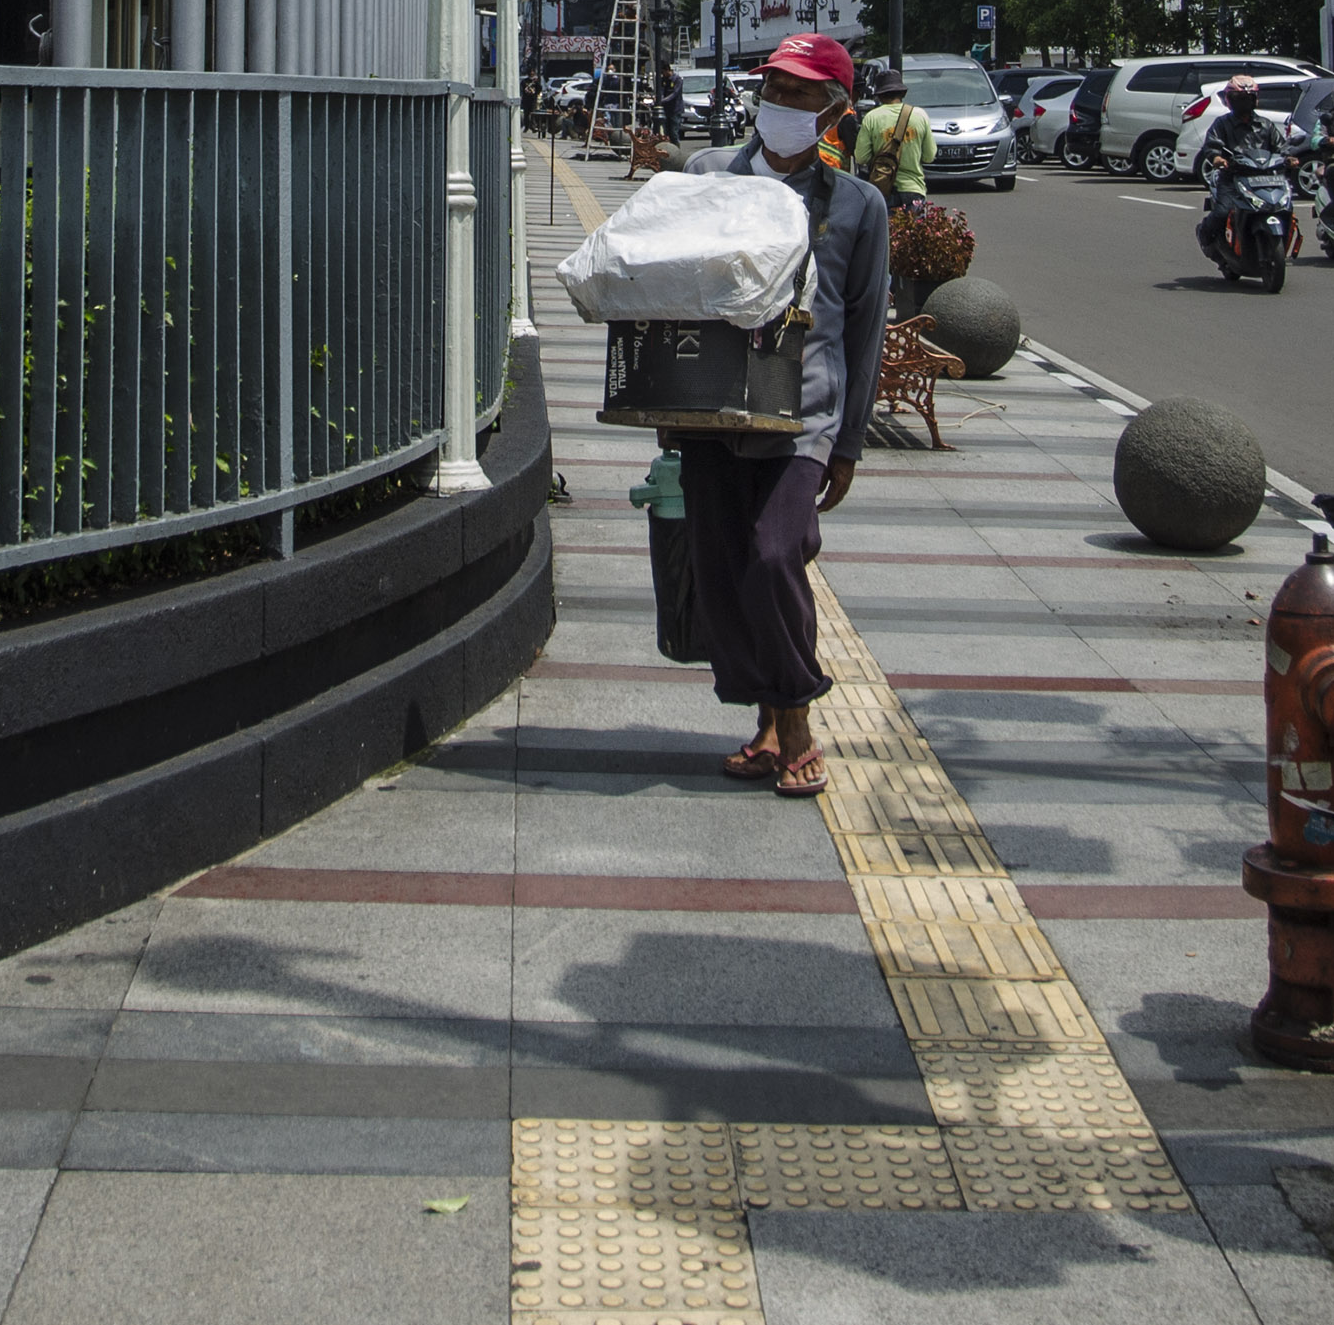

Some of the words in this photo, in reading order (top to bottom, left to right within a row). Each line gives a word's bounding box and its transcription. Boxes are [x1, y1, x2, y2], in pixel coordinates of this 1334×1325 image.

[980, 8, 990, 21] P
[609, 369, 618, 398] MUDA
[617, 360, 627, 389] NYALI
